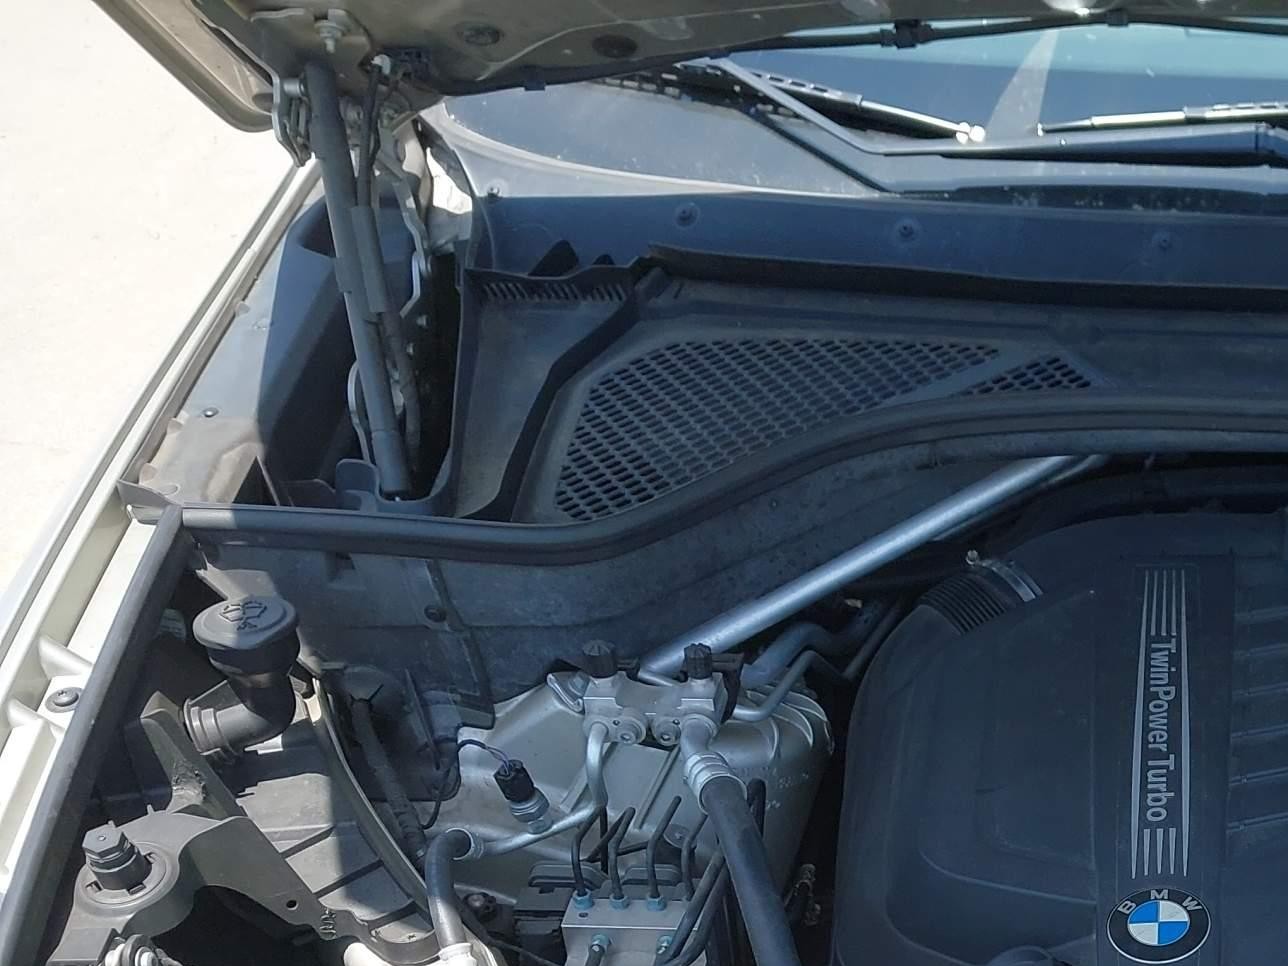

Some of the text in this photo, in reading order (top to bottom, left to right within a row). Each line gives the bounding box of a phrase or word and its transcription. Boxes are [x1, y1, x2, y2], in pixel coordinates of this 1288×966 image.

[1145, 638, 1177, 822] TwinPower Turbo
[1118, 888, 1203, 915] BMW
